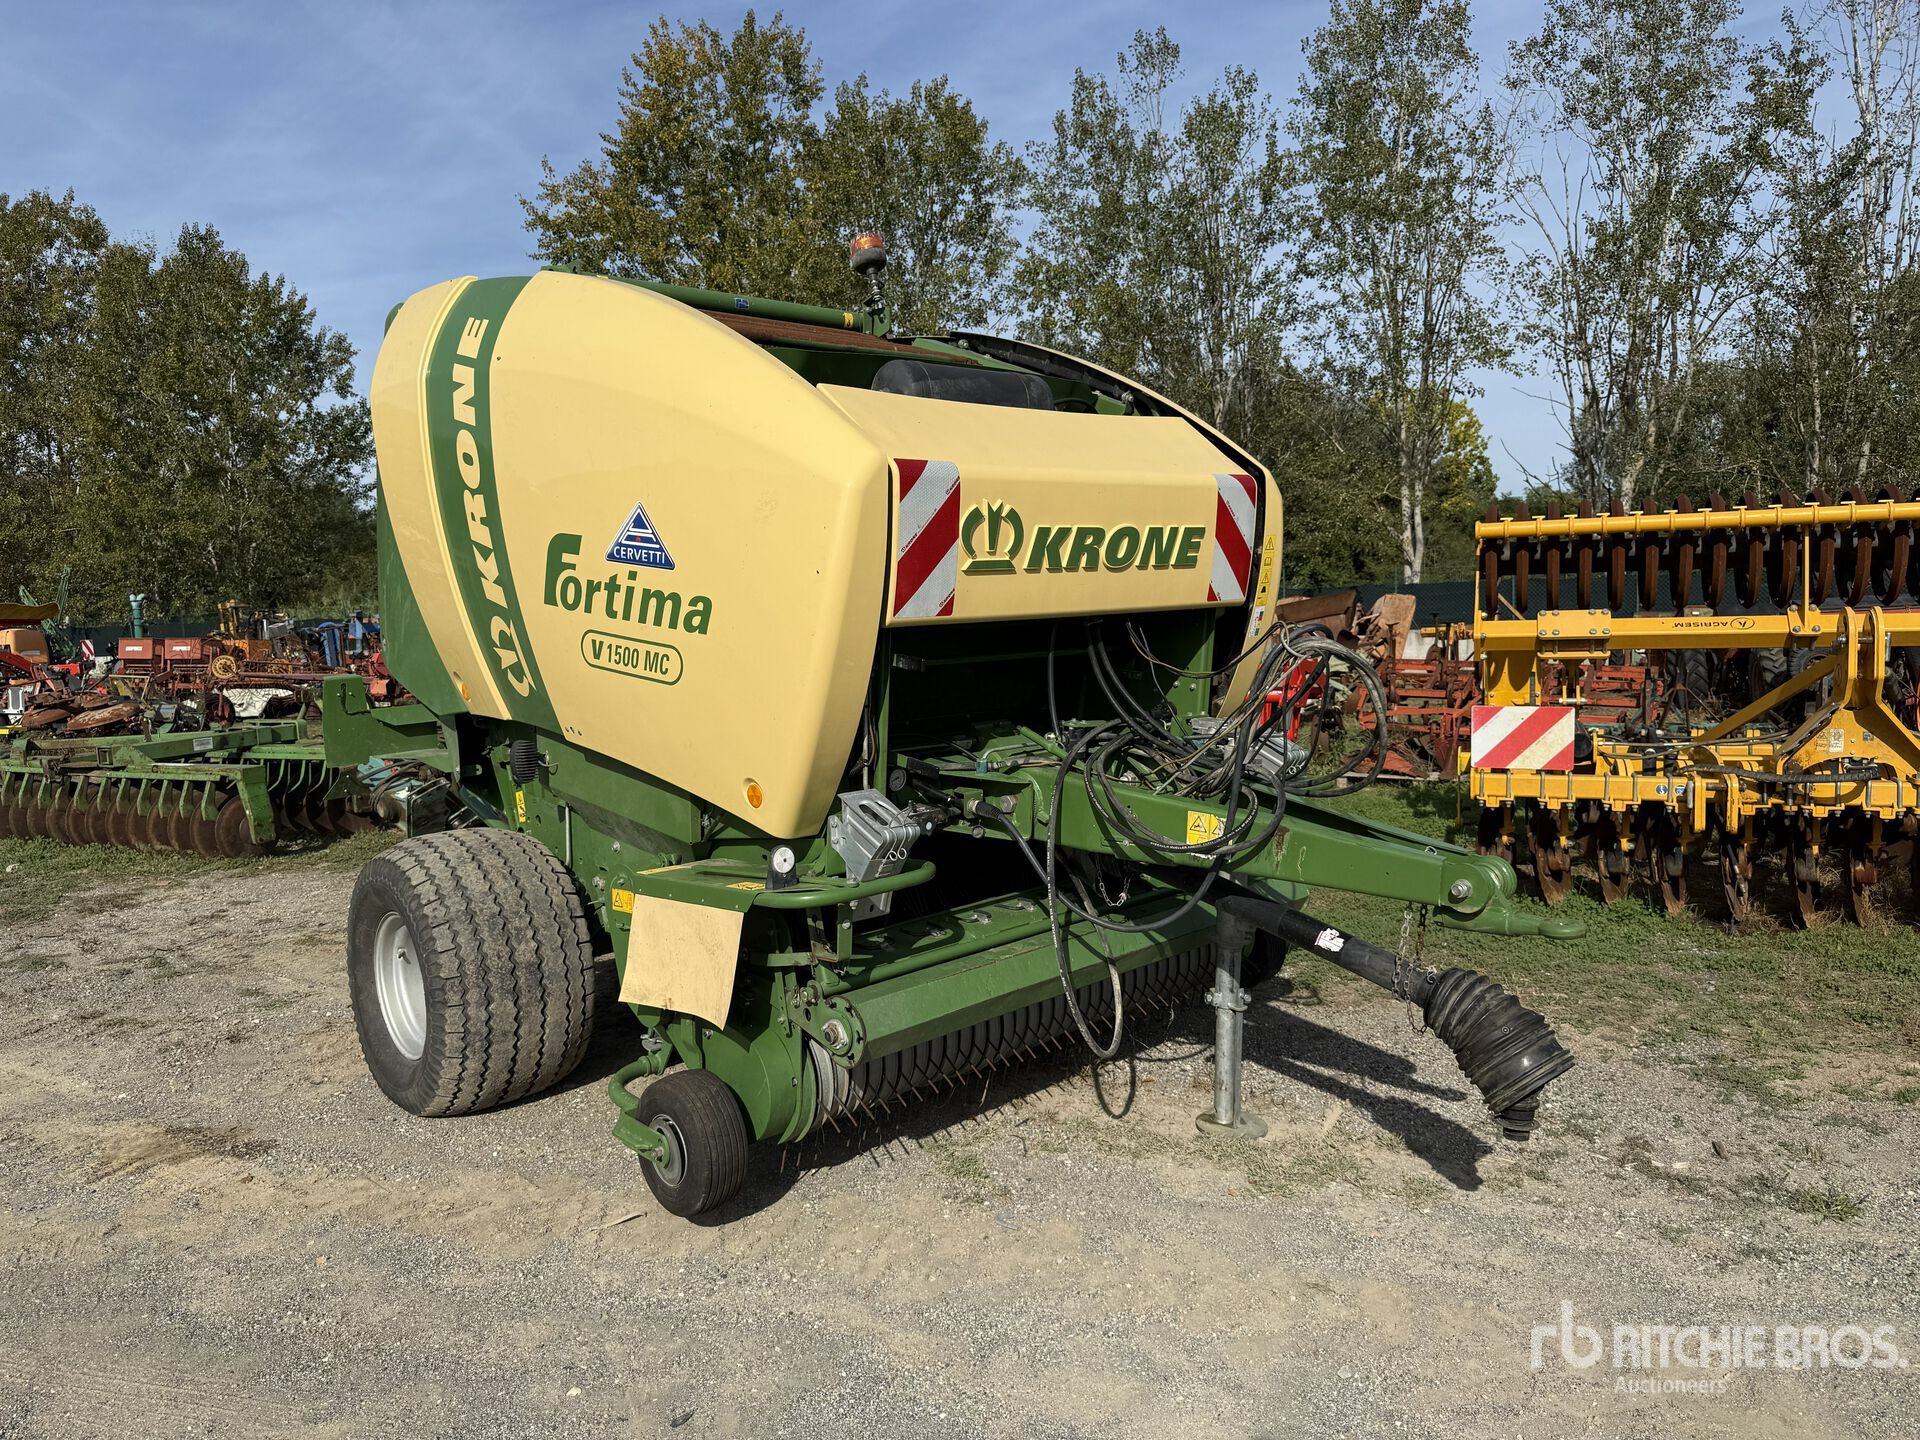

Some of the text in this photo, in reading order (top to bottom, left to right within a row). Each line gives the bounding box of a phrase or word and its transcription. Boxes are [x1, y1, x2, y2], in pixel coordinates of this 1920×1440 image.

[452, 317, 508, 609] KRONE
[613, 546, 665, 564] CERVETTI
[1023, 524, 1206, 572] KRONE
[543, 532, 713, 635] Fortima
[591, 639, 670, 675] V 1500 MC
